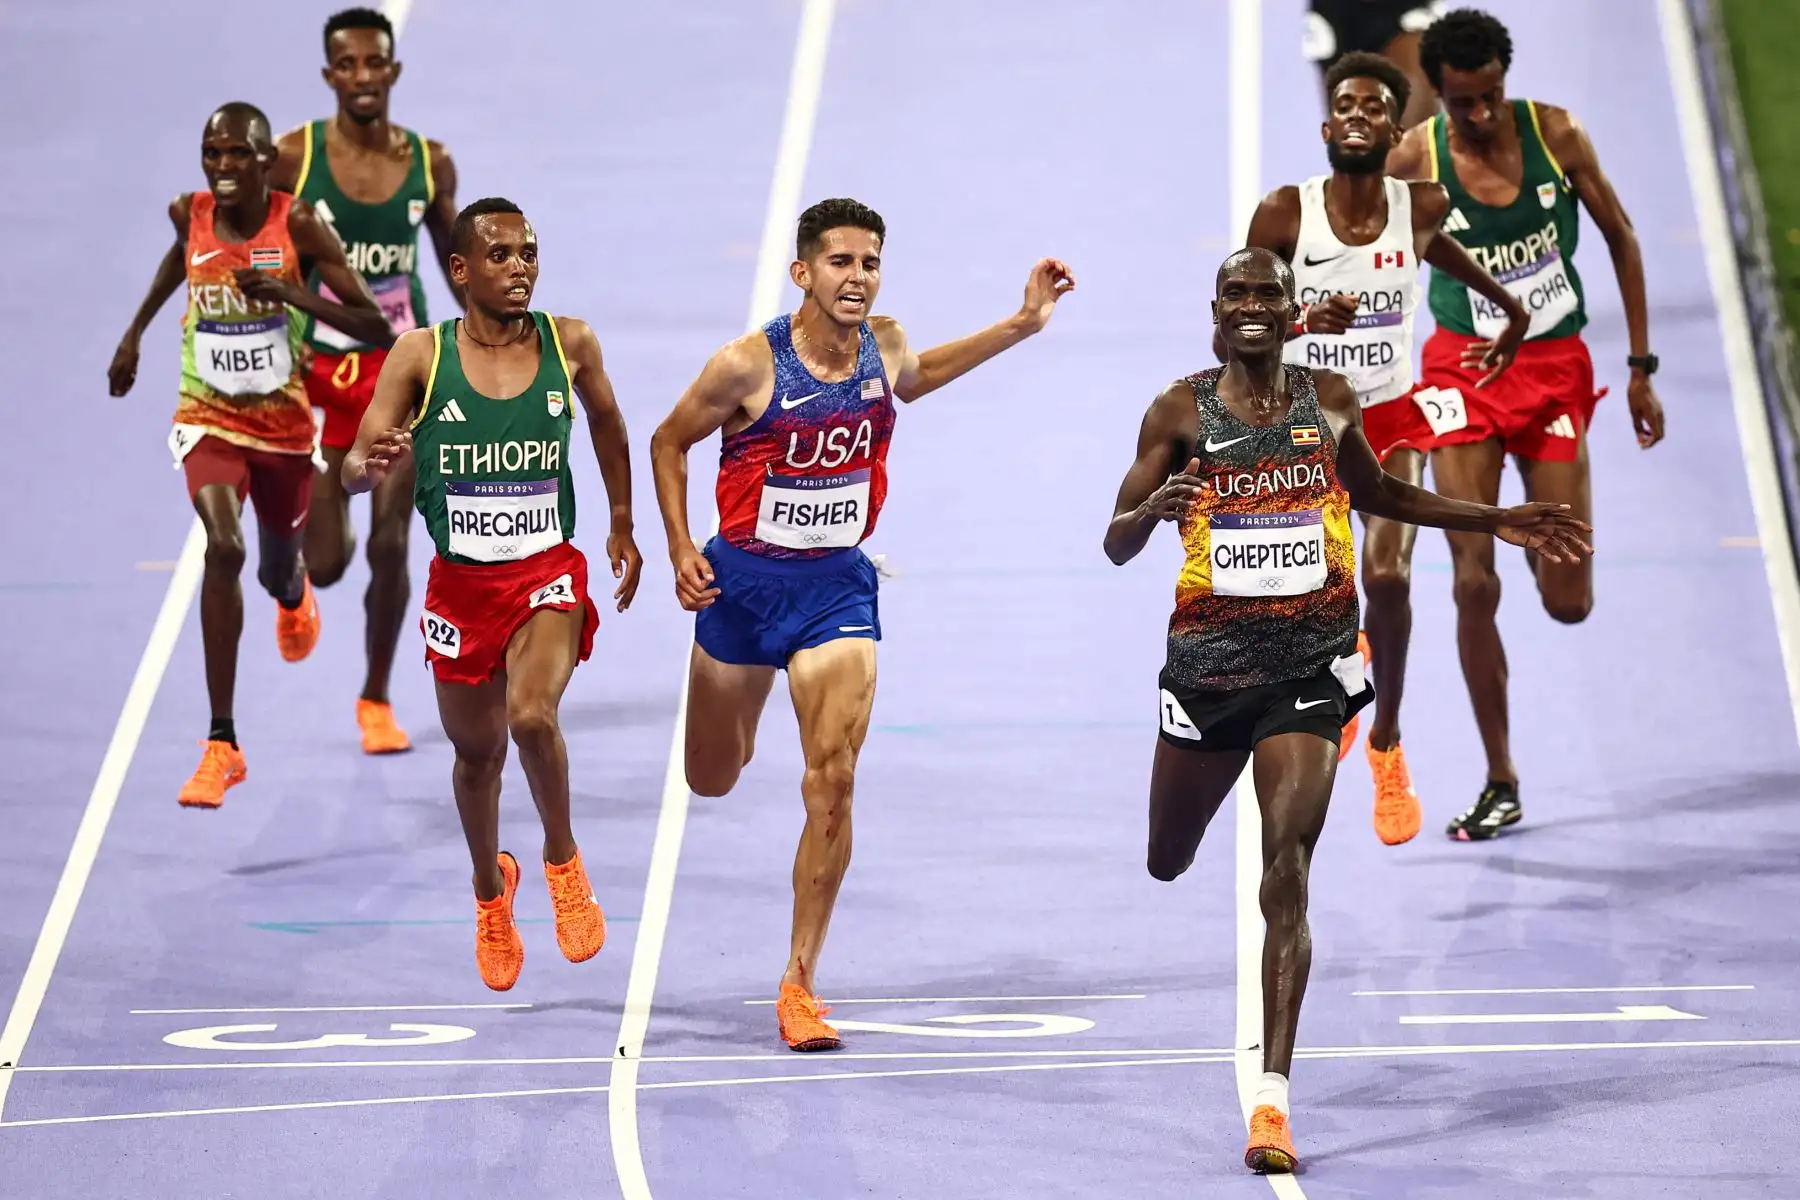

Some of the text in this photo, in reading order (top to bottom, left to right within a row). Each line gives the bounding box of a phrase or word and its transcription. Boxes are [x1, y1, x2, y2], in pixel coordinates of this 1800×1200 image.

[211, 343, 274, 372] KIBET
[1307, 341, 1394, 367] AHMED
[439, 440, 560, 475] ETHIOPIA
[785, 419, 872, 469] USA
[475, 484, 534, 494] PARIS 2024
[795, 477, 849, 487] PARIS 2024
[1214, 463, 1327, 498] UGANDA
[451, 507, 558, 537] AREGAWI
[772, 499, 858, 527] FISHER
[1240, 515, 1299, 526] PARIS 2024
[1214, 539, 1321, 570] CHEPTEGEI
[427, 618, 456, 647] 22
[1399, 1005, 1709, 1024] 1
[162, 1022, 477, 1051] 3
